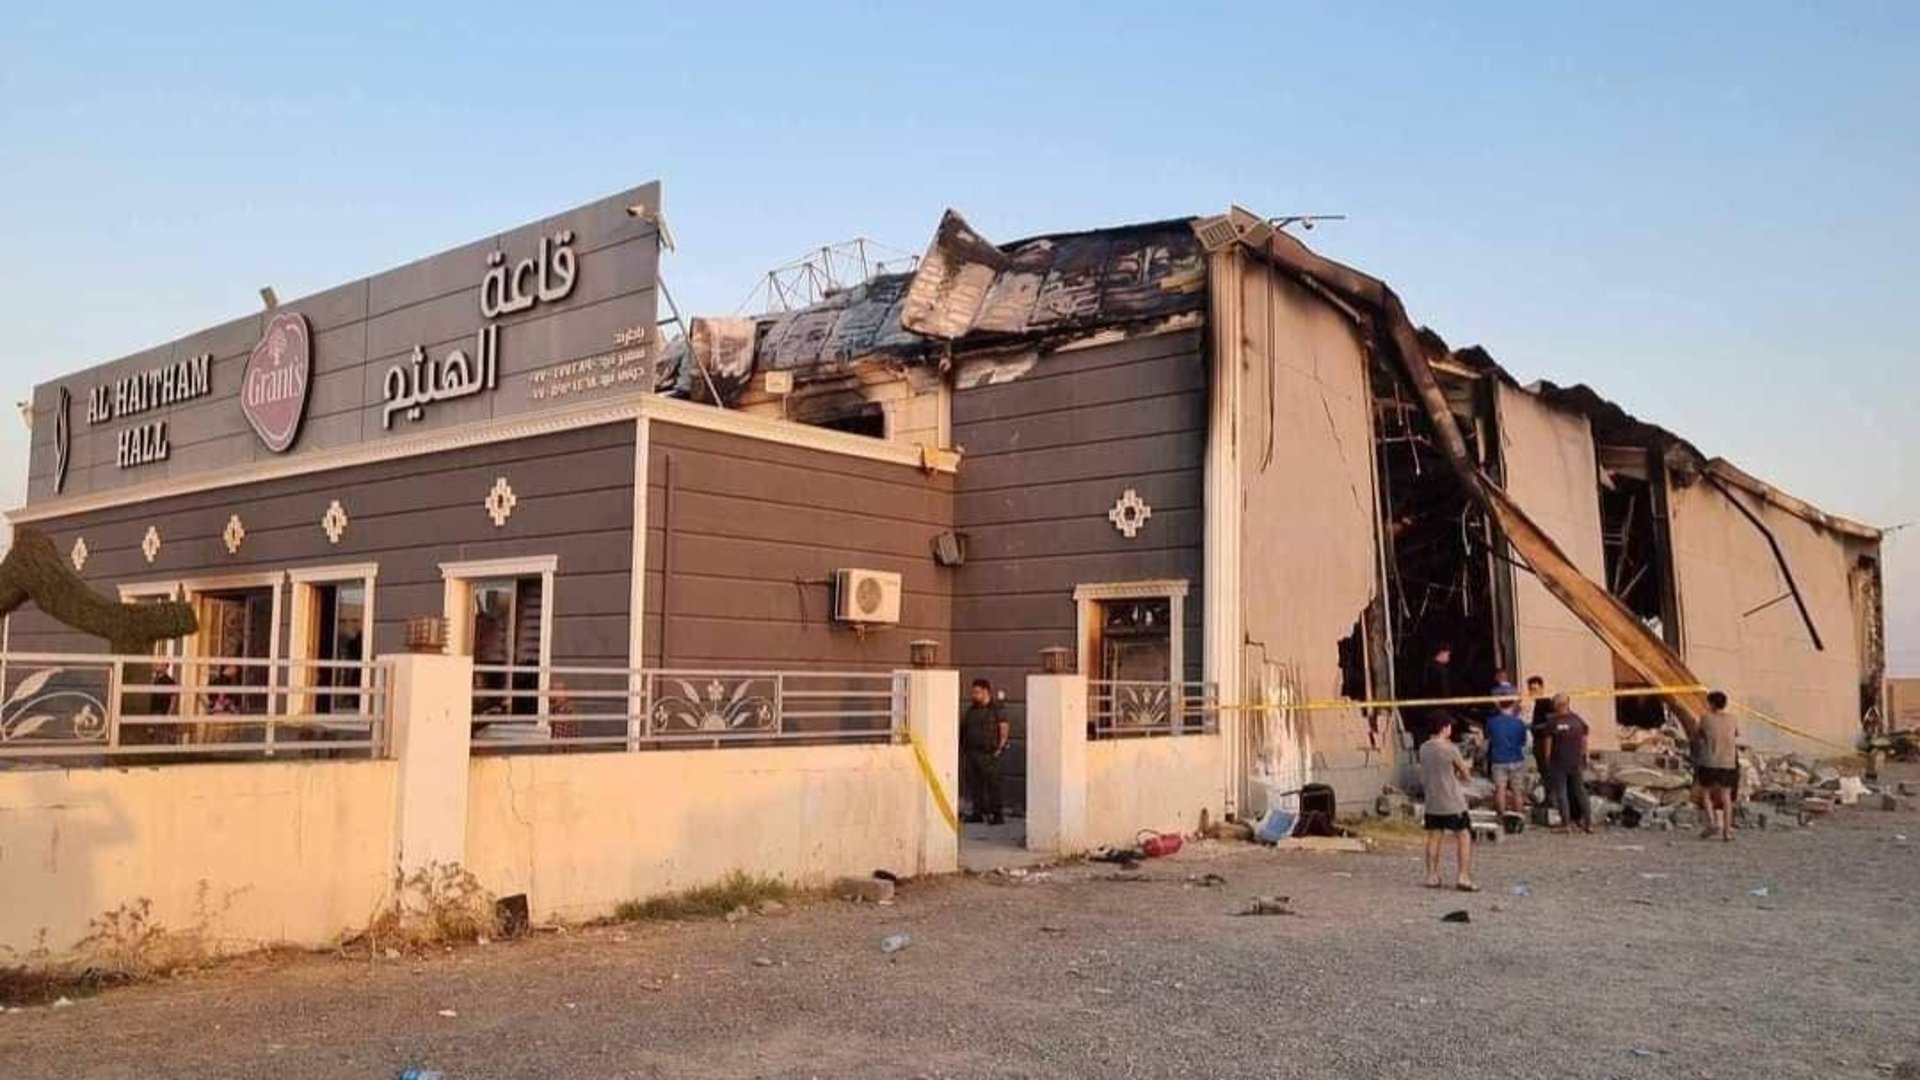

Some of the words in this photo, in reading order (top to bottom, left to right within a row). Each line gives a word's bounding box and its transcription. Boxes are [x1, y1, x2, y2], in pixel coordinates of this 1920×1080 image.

[481, 230, 576, 319] قاعة
[87, 386, 110, 424] AL
[114, 353, 211, 417] HAITHAM
[383, 323, 498, 430] الهيثم
[116, 421, 169, 468] HALL
